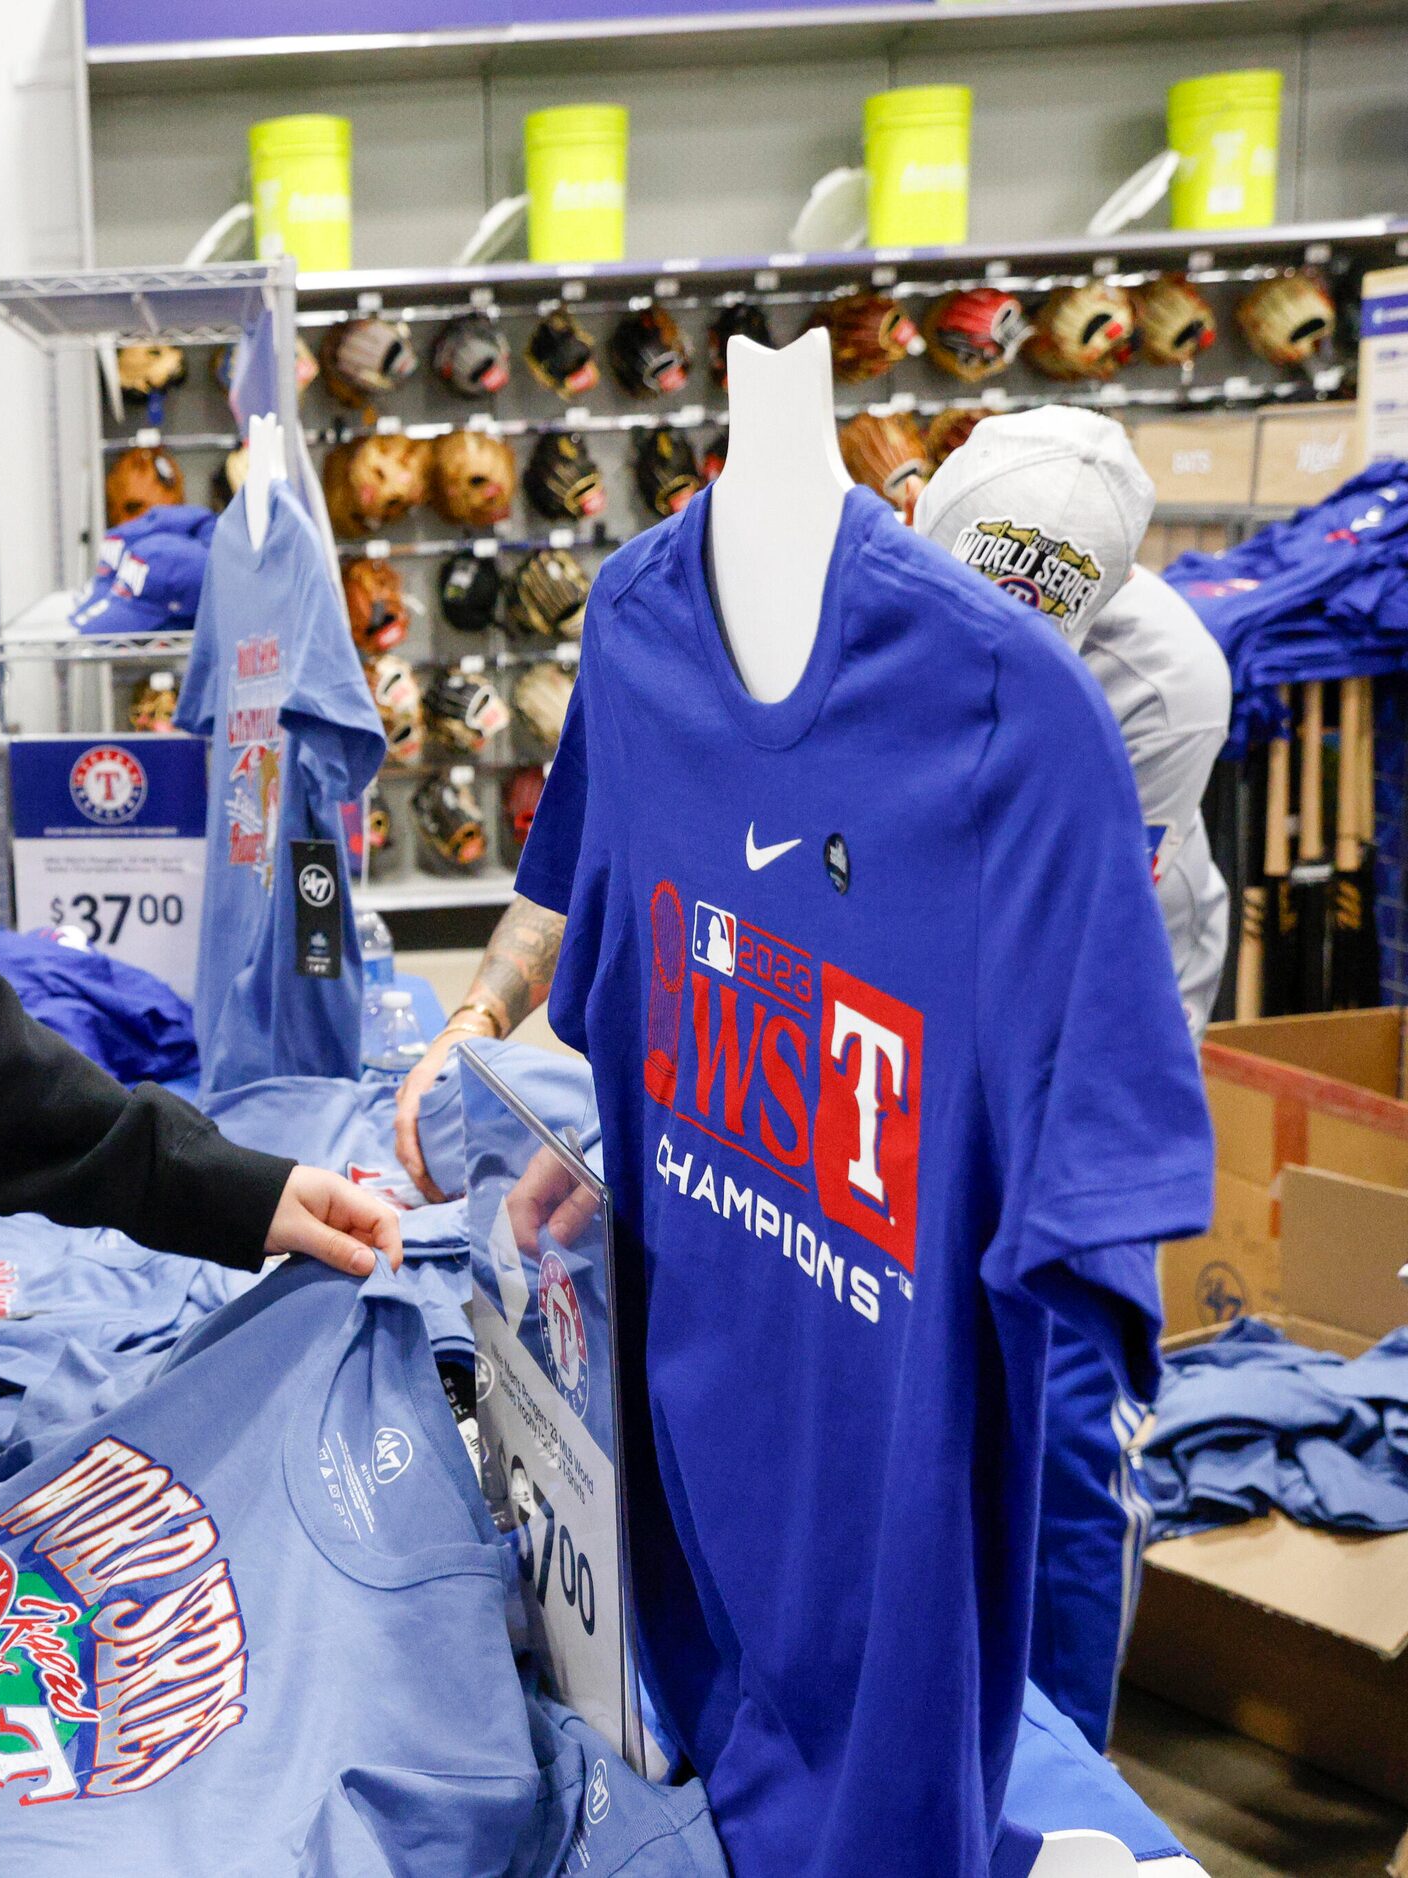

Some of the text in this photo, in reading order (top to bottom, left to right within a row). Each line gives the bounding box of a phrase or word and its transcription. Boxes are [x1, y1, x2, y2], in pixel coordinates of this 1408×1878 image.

[952, 532, 1039, 577] WORLD
[96, 771, 120, 801] T
[737, 934, 813, 1004] 2023
[690, 970, 810, 1168] WS
[829, 999, 905, 1205] T
[655, 1133, 881, 1324] CHAMPIONS
[516, 1394, 536, 1439] Trophy
[561, 1458, 586, 1505] T-Shirts
[521, 1382, 547, 1430] Rangers
[559, 1434, 573, 1466] MLB
[573, 1453, 594, 1496] World
[87, 1557, 247, 1797] SERIES
